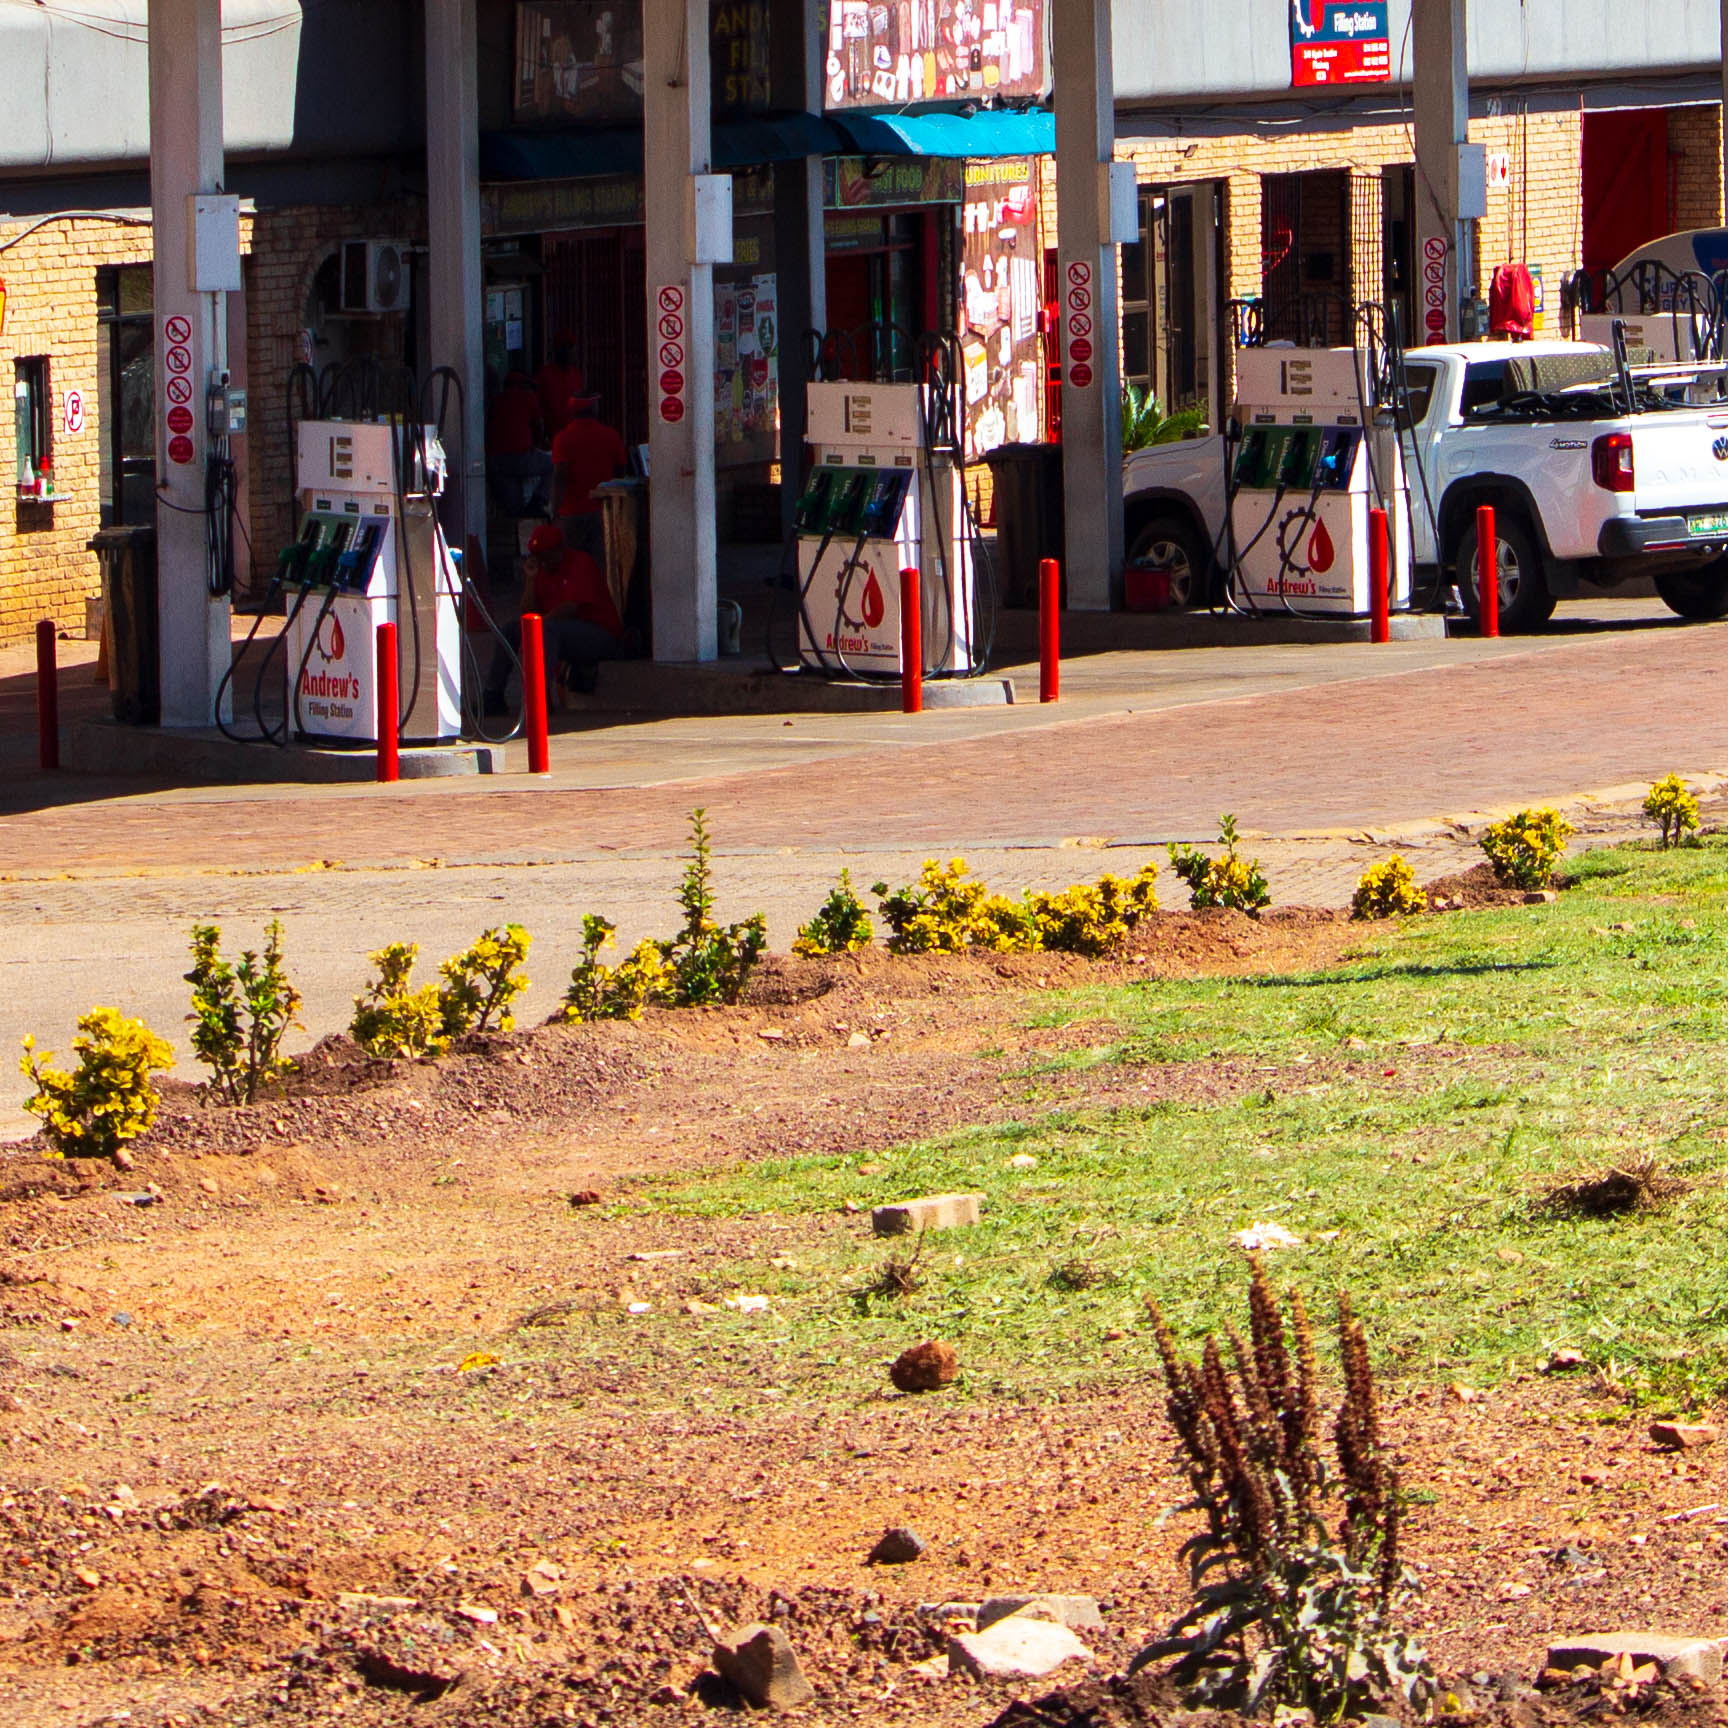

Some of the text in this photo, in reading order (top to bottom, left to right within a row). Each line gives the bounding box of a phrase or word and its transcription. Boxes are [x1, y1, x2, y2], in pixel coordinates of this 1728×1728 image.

[1354, 11, 1377, 32] Station
[302, 668, 359, 700] Andrew's
[308, 701, 353, 719] Filling Station
